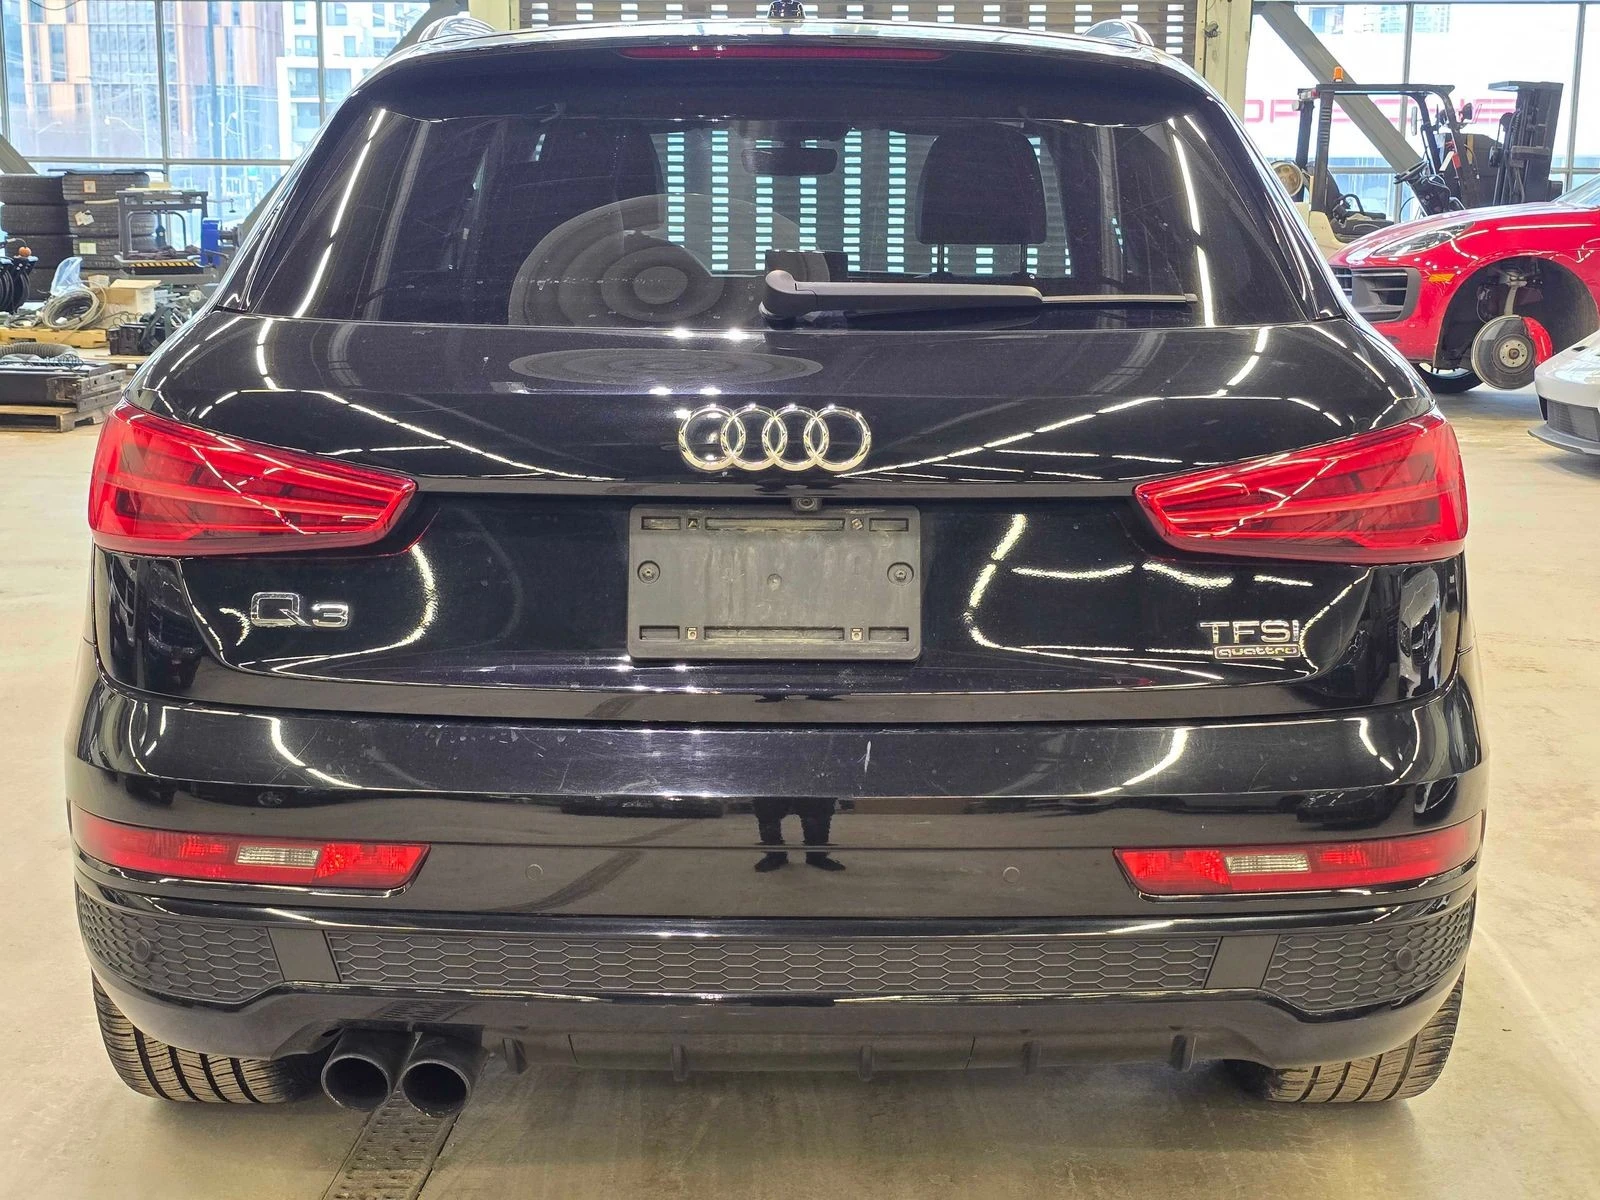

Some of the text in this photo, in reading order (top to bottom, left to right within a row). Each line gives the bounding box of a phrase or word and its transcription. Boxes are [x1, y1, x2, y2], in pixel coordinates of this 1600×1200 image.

[250, 591, 349, 628] Q3
[1199, 619, 1300, 643] TFSI
[1218, 646, 1298, 658] quattro
